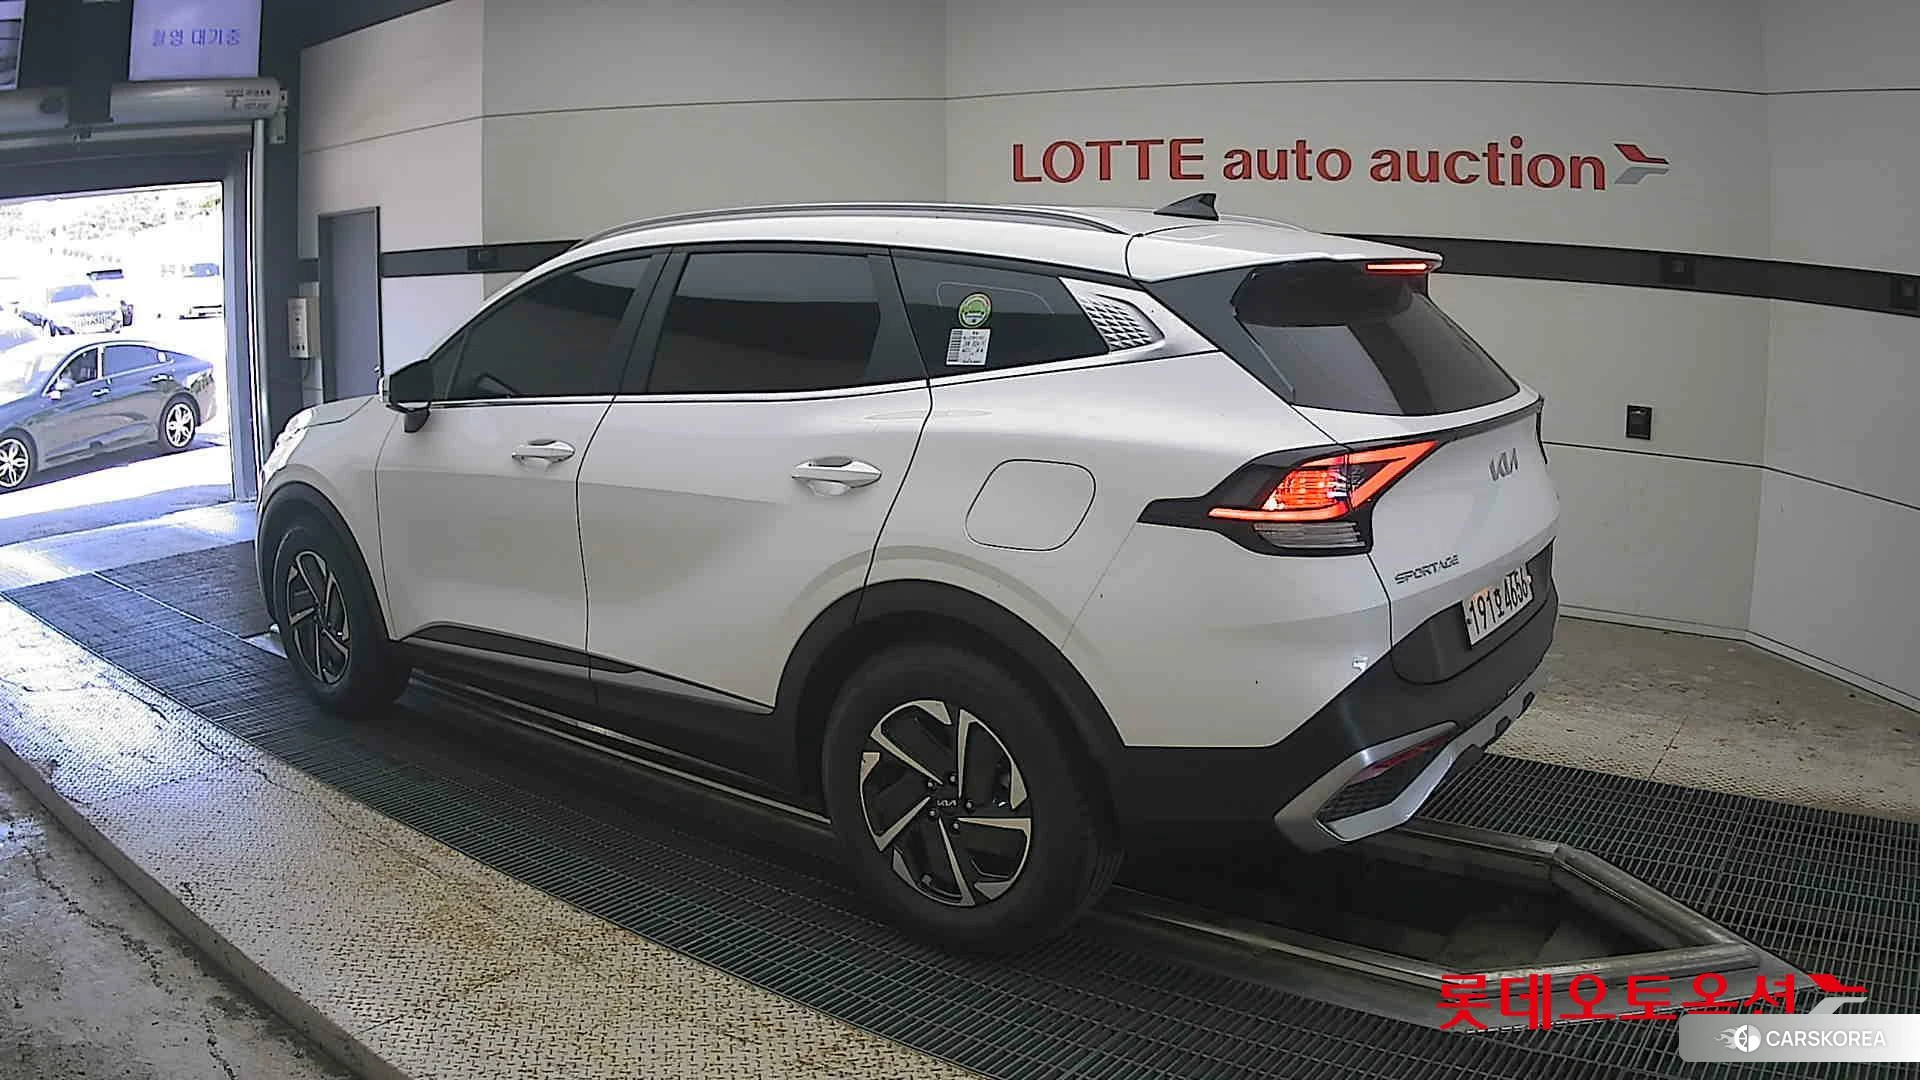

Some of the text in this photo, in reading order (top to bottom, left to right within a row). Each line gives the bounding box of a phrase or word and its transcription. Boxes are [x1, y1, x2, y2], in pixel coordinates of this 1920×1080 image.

[191, 28, 241, 47] 대기중
[1012, 134, 1606, 191] LOTTE auto auction
[1488, 447, 1519, 482] KIA
[1394, 554, 1460, 585] SPORTAGE
